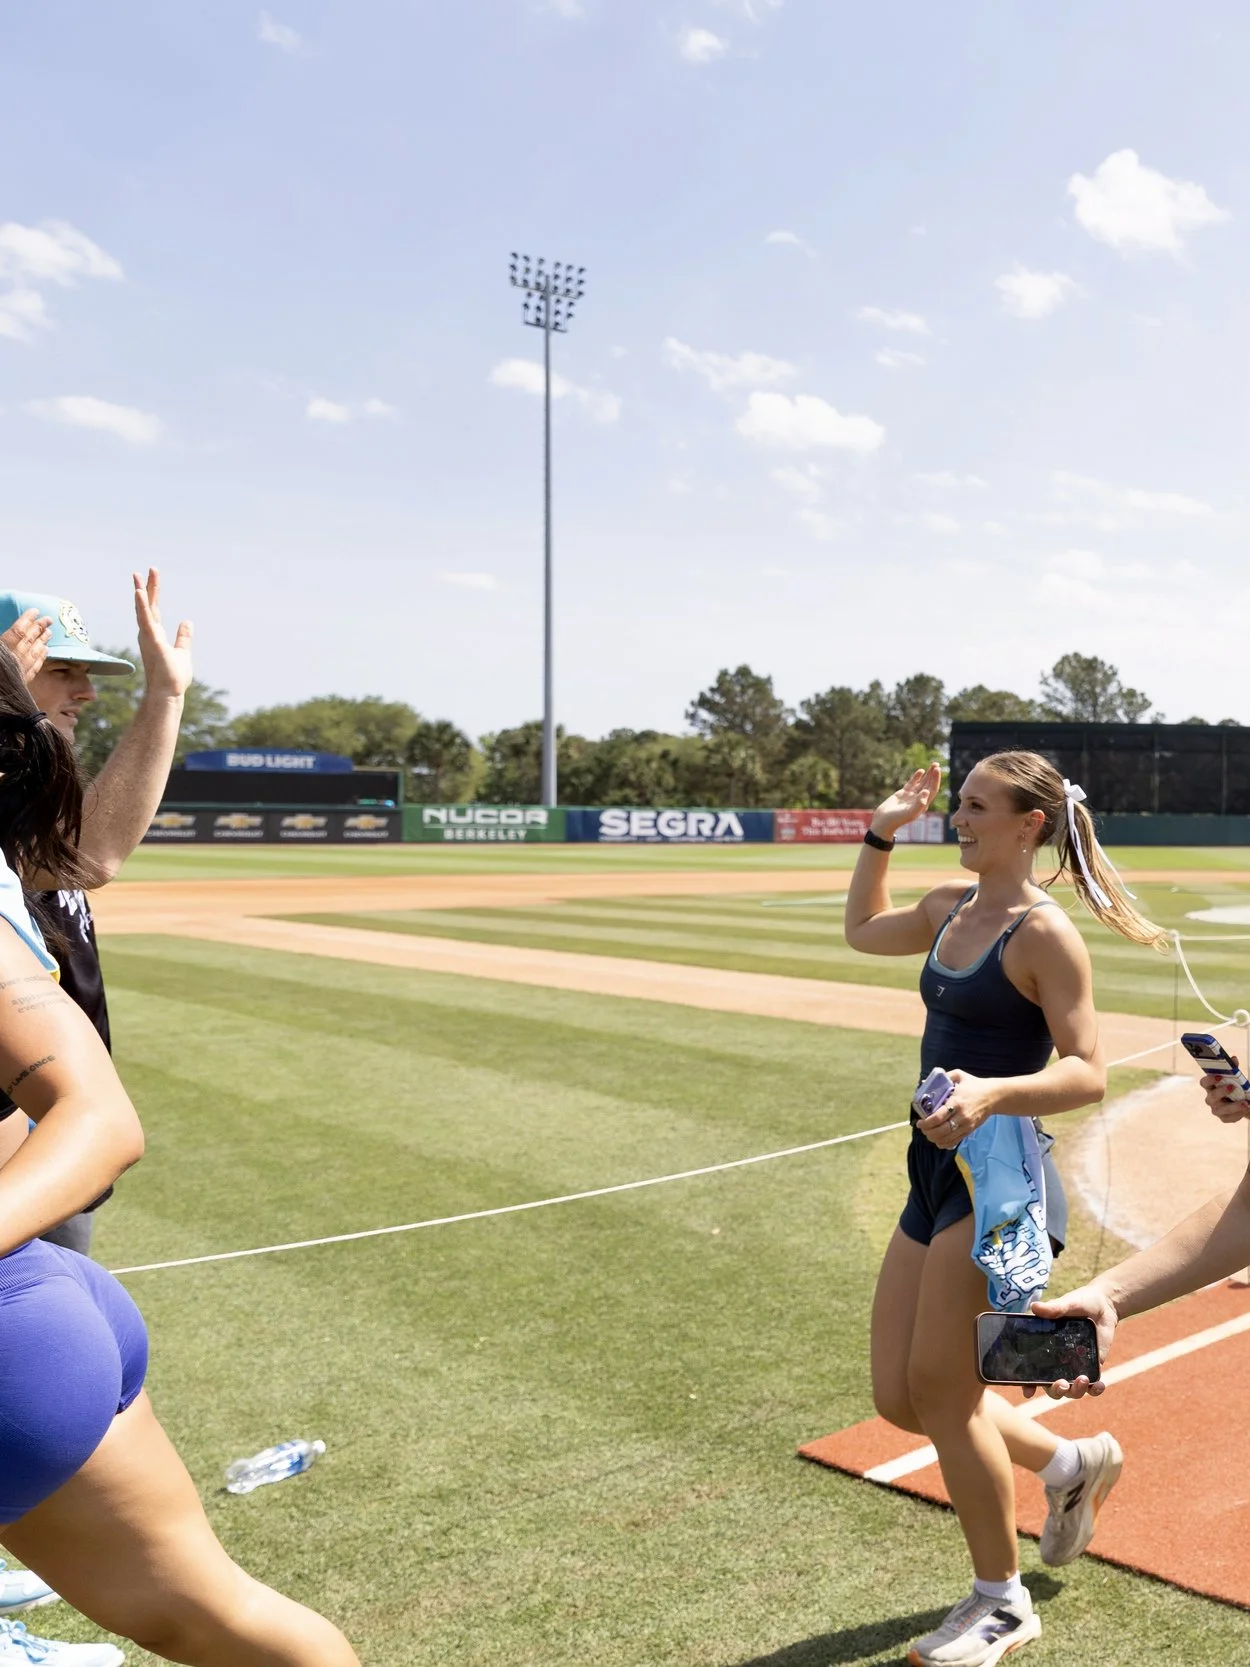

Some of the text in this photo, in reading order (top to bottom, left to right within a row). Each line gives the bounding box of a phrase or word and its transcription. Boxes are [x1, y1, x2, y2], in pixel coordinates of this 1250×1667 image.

[226, 752, 316, 769] BUD LIGHT
[422, 808, 549, 825] NUCOR
[599, 808, 745, 837] SEGRA
[443, 828, 527, 840] BERKELEY
